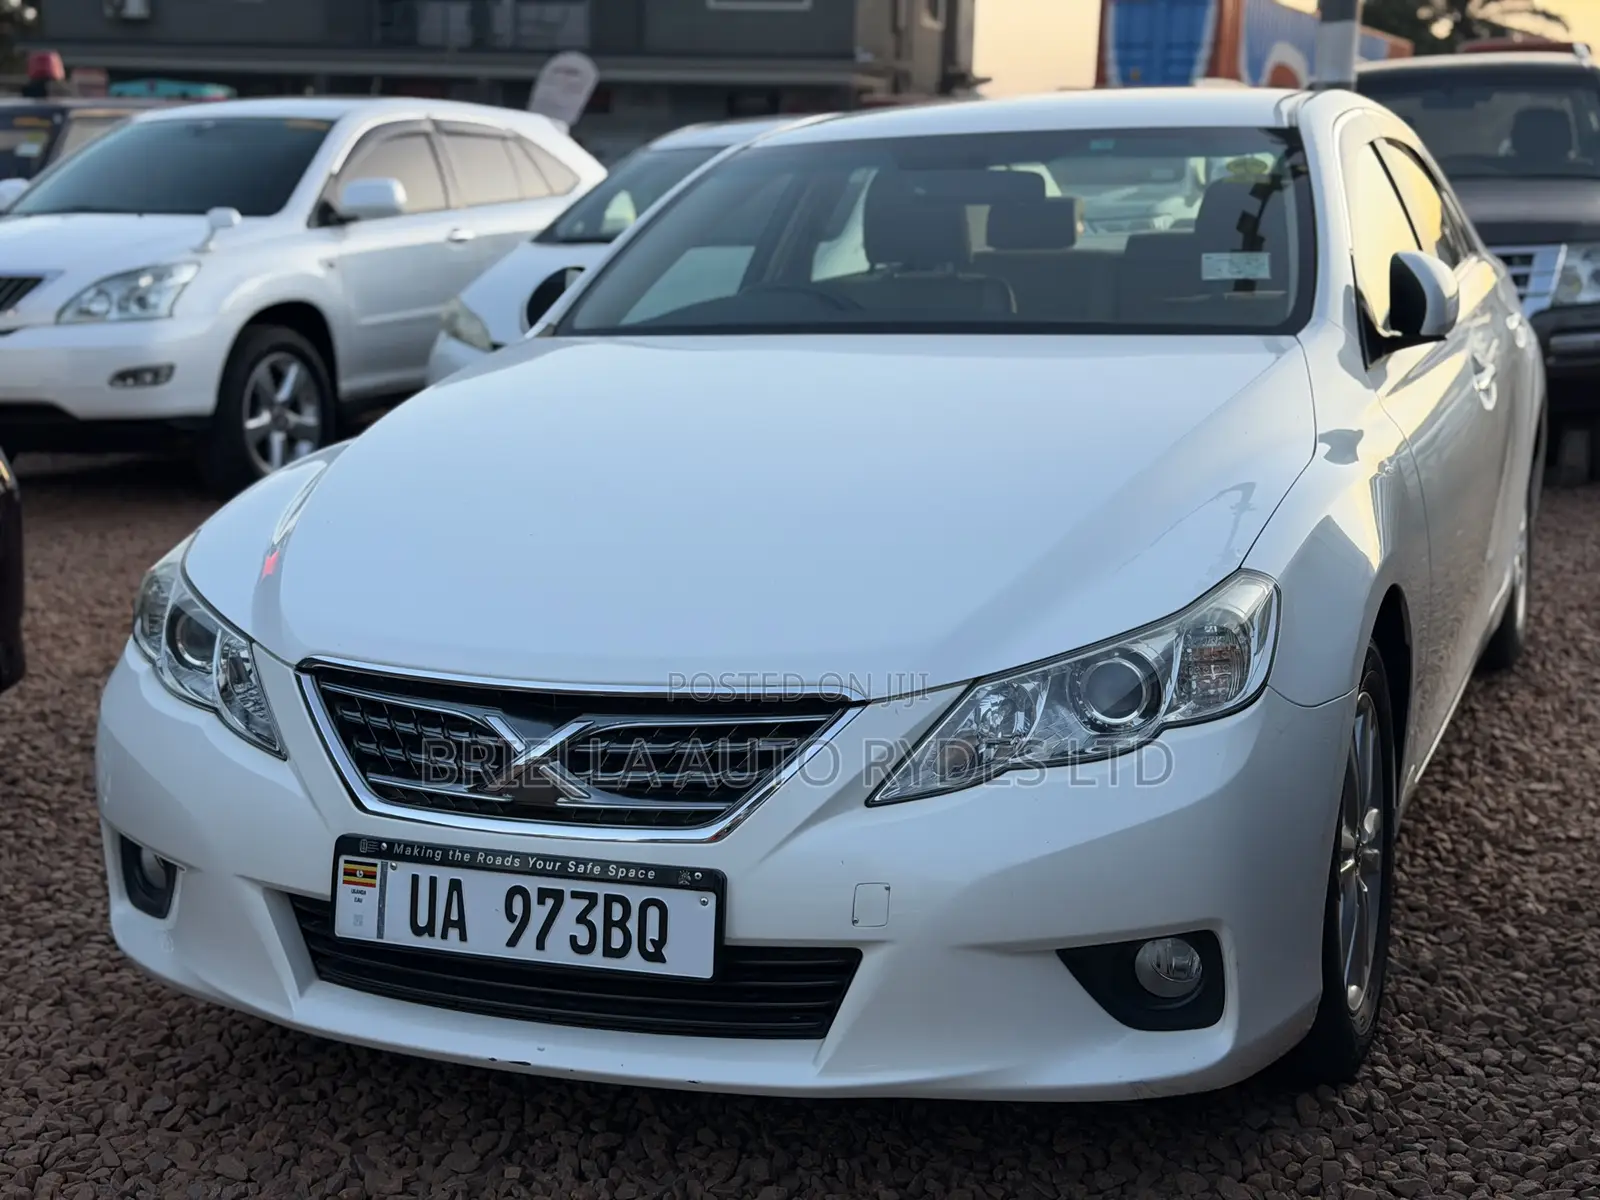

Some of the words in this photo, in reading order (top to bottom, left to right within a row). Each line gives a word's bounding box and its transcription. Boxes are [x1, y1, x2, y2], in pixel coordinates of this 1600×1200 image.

[393, 843, 443, 861] Making
[448, 849, 471, 862] the
[477, 852, 521, 867] Roads
[528, 856, 562, 871] Your
[567, 860, 602, 875] Safe
[607, 864, 656, 879] Space
[409, 873, 468, 942] UA
[504, 884, 669, 964] 973BQ
